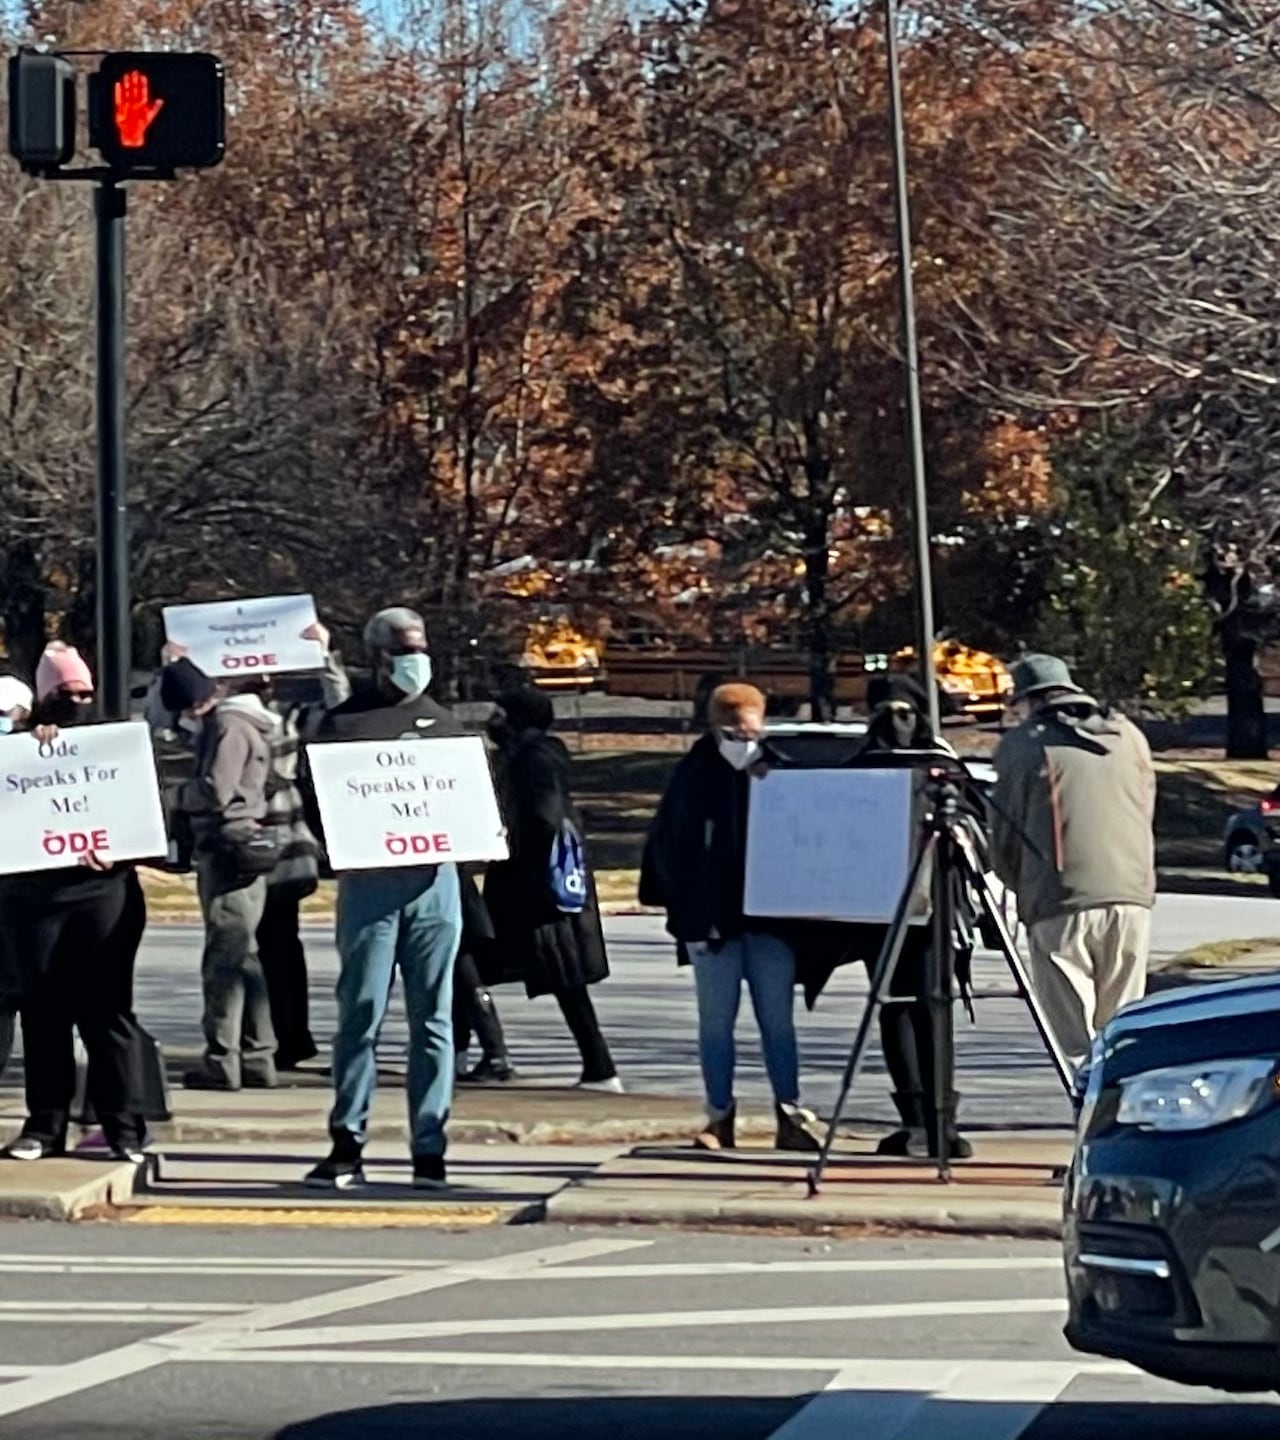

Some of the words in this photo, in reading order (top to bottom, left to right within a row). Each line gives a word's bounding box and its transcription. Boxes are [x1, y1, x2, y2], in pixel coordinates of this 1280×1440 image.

[221, 653, 278, 669] ODE
[38, 740, 80, 759] Ode
[376, 751, 417, 768] Ode
[5, 769, 78, 795] Speaks
[83, 765, 119, 783] For
[346, 777, 417, 798] Speaks
[422, 774, 457, 791] For
[51, 794, 90, 815] Me!
[391, 800, 430, 818] Me!
[42, 828, 110, 856] ODE
[385, 831, 452, 856] ODE
